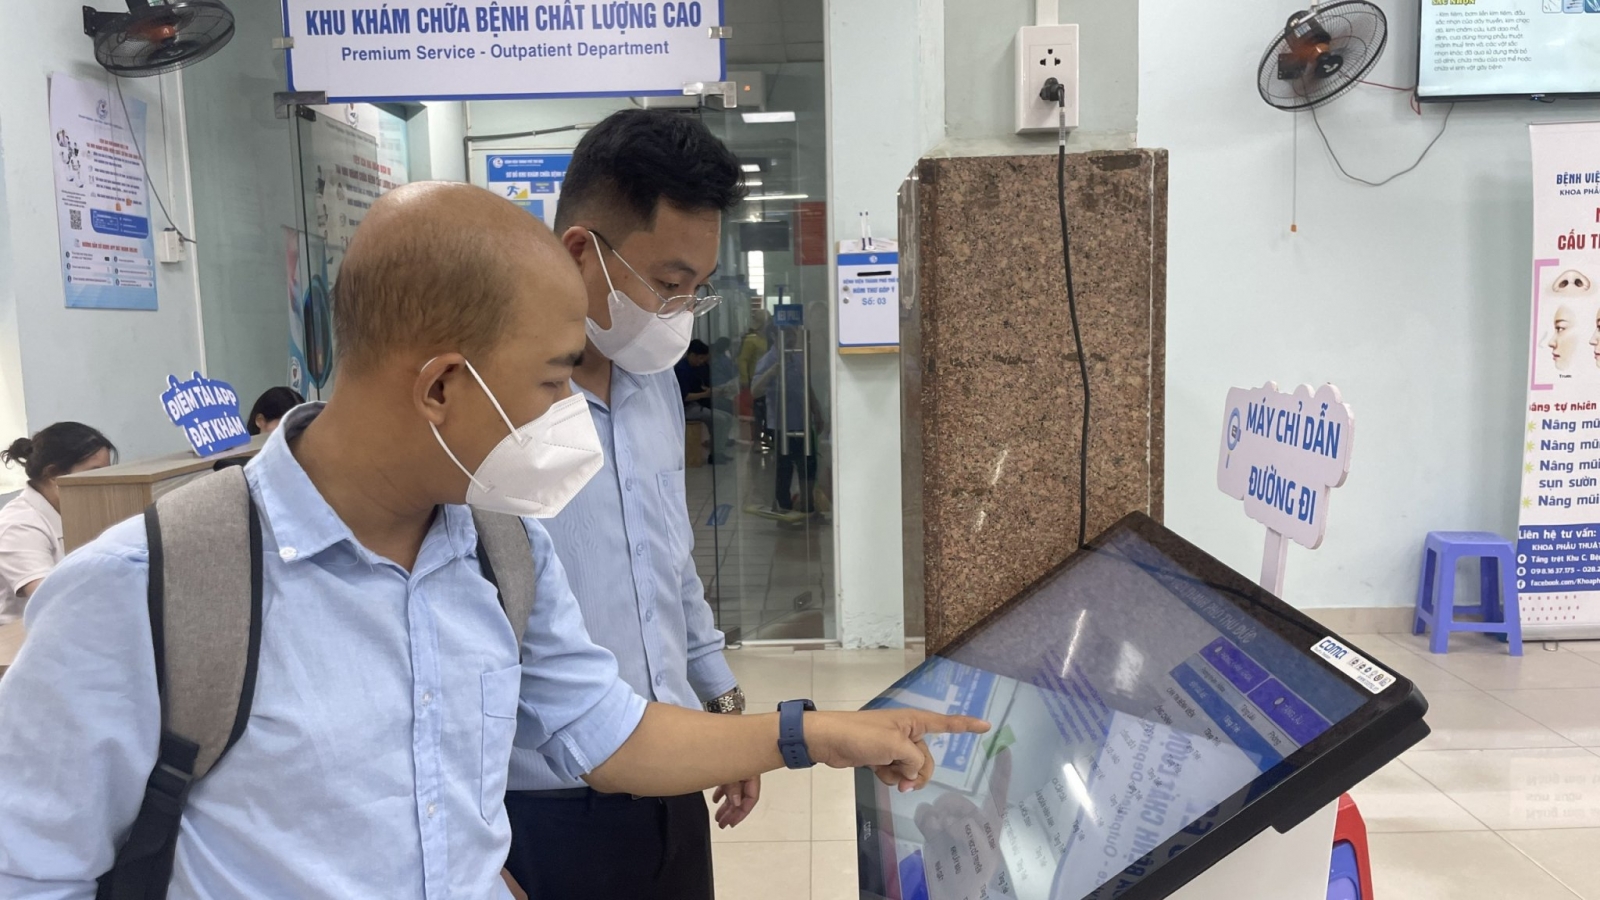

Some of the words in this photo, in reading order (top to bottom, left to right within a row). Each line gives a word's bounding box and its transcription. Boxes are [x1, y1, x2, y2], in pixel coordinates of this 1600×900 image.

[306, 8, 345, 36] KHU
[352, 2, 410, 34] KHÁM
[417, 1, 470, 34] CHỮA
[476, 1, 529, 38] BỆNH
[592, 1, 656, 34] LƯỢNG
[663, 0, 701, 28] CAO
[341, 46, 411, 61] Premium
[417, 44, 475, 59] Service
[490, 42, 571, 59] Outpatient
[578, 40, 669, 58] Department
[1557, 172, 1581, 186] BỆNH
[1558, 229, 1585, 250] CẤU
[168, 382, 199, 421] ĐIỂM
[214, 386, 236, 406] APP
[1571, 401, 1596, 411] nhiên
[189, 418, 215, 452] ĐẶT
[210, 411, 246, 440] KHÁM
[1246, 398, 1275, 438] MÁY
[1276, 401, 1302, 447] CHỈ
[1302, 403, 1341, 459] DẪN
[1542, 419, 1576, 432] Nâng
[1541, 440, 1574, 453] Nâng
[1540, 460, 1573, 473] Nâng
[1539, 479, 1562, 491] sụn
[1569, 476, 1596, 487] sườn
[1248, 465, 1296, 515] ĐƯỜNG
[1298, 486, 1316, 525] ĐI
[1538, 495, 1571, 508] Nâng
[1577, 494, 1599, 505] mũi
[1519, 530, 1539, 539] Liên
[1544, 530, 1556, 540] hệ
[1561, 530, 1572, 538] tư
[1576, 527, 1596, 537] vấn:
